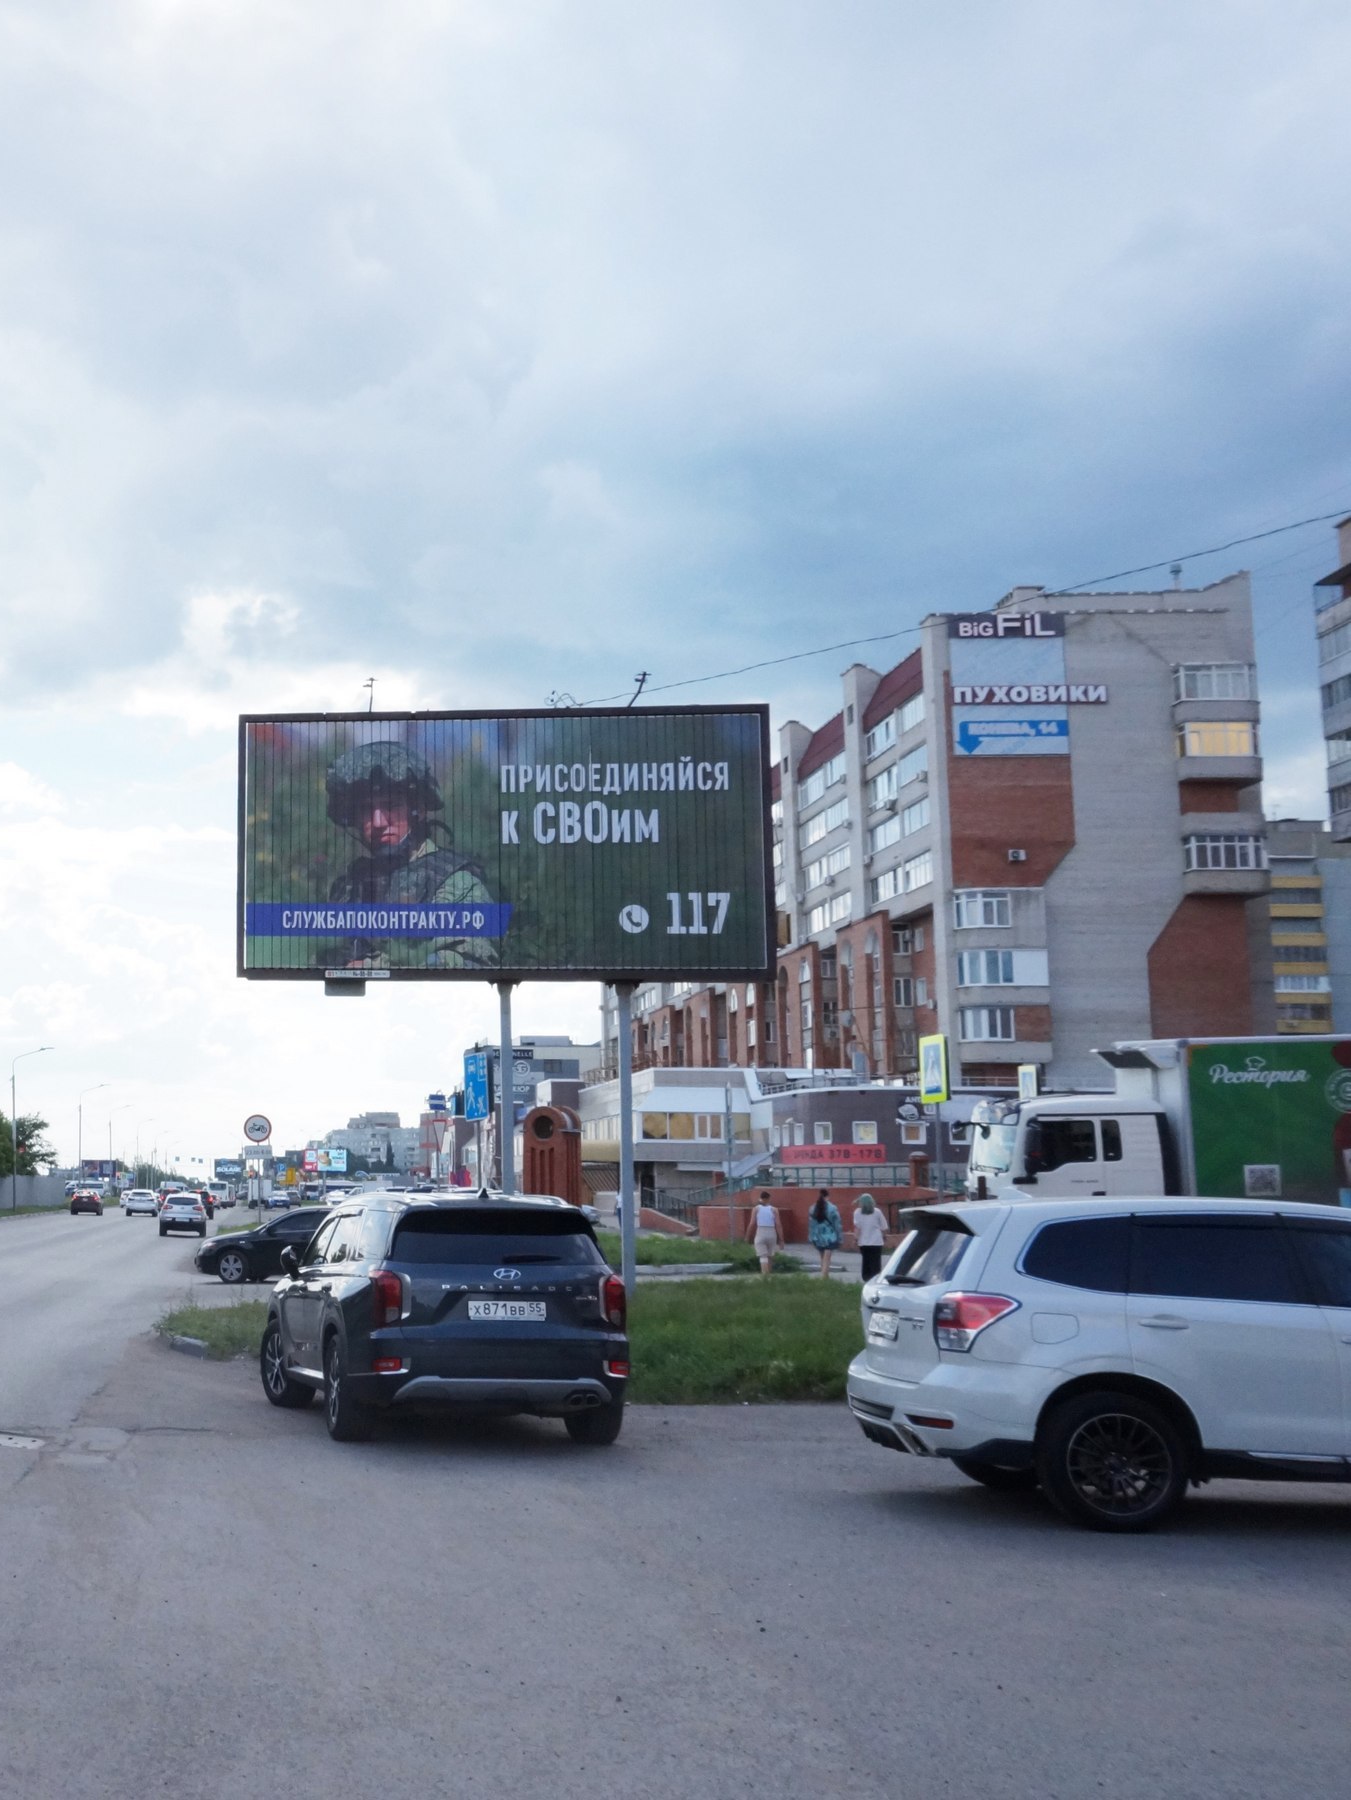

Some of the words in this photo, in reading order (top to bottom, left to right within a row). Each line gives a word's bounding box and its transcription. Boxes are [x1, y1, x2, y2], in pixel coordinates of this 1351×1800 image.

[953, 685, 1108, 703] ПУХОВИКИ
[500, 756, 730, 795] ПРИСОЕДИНЯЙСЯ
[282, 910, 485, 930] СЛУЖБАПОКОНТРАКТУ.РФ
[666, 892, 731, 935] 117
[1209, 1063, 1310, 1088] Рестория
